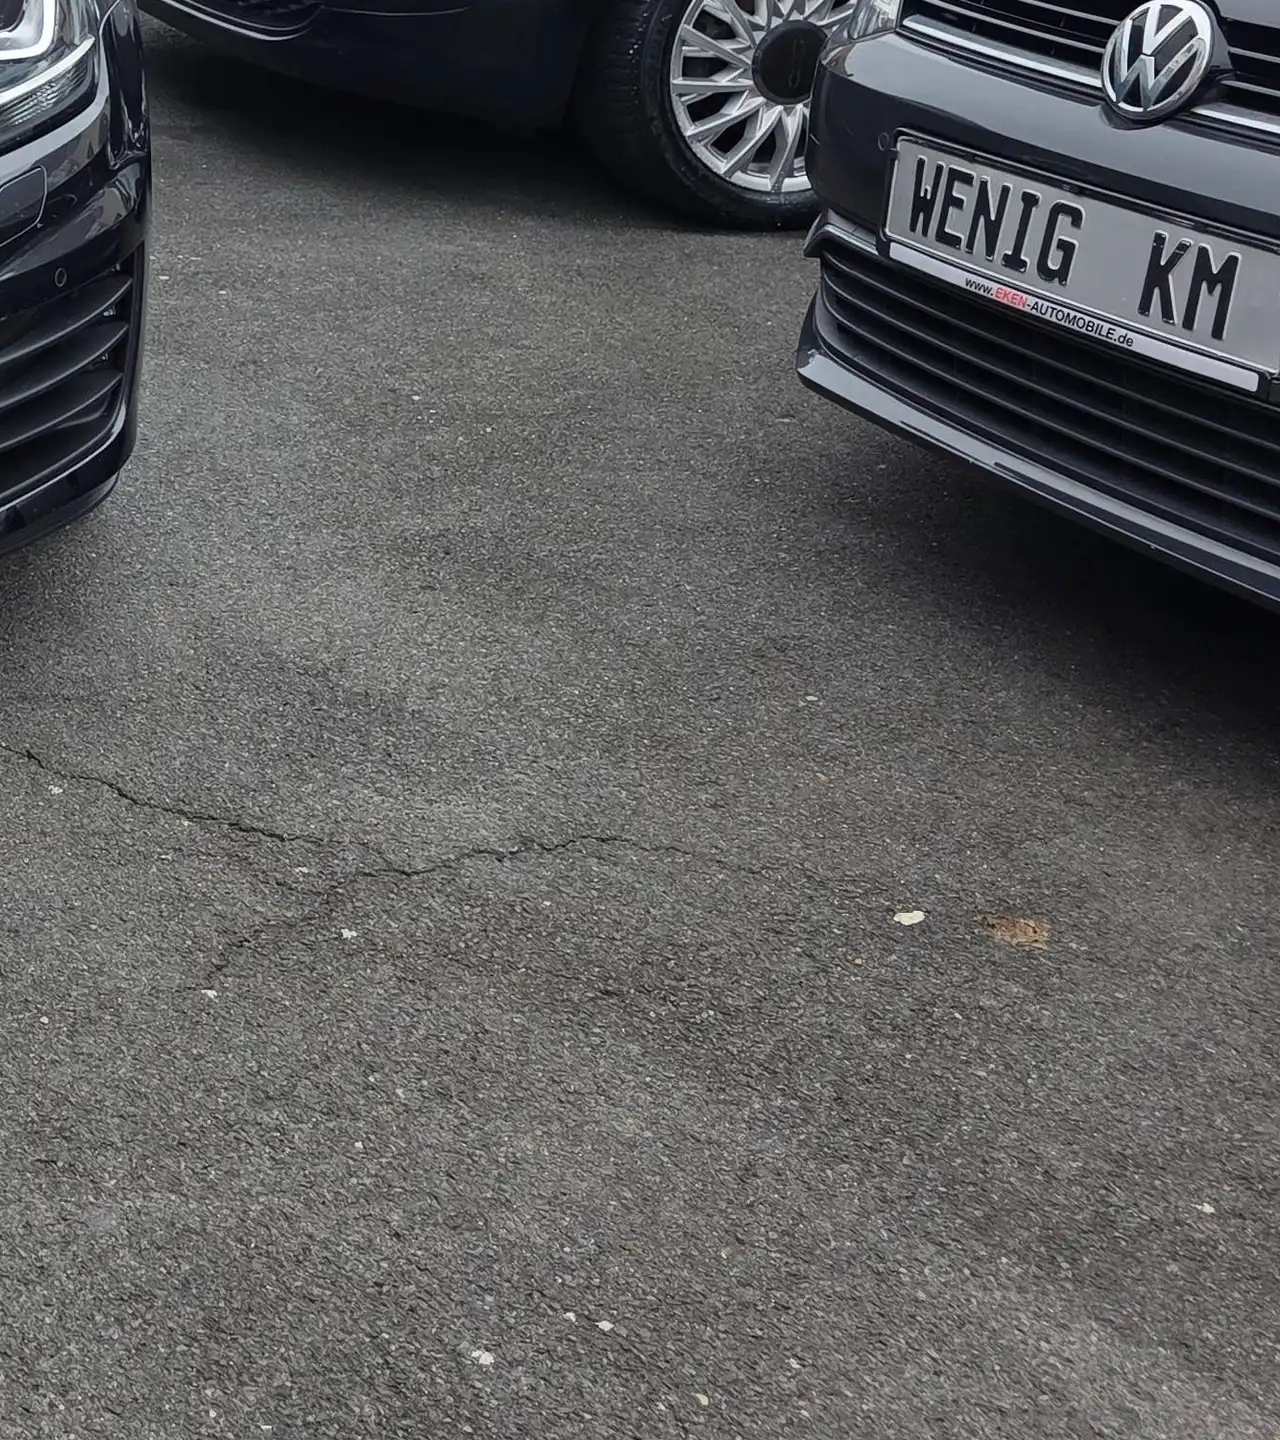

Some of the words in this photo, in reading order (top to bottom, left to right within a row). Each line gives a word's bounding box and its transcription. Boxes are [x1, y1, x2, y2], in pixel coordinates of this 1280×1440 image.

[908, 154, 1087, 288] WENIG
[1137, 228, 1243, 342] KM
[964, 276, 1134, 348] www.EKEN-AUTOMOBILE.de
